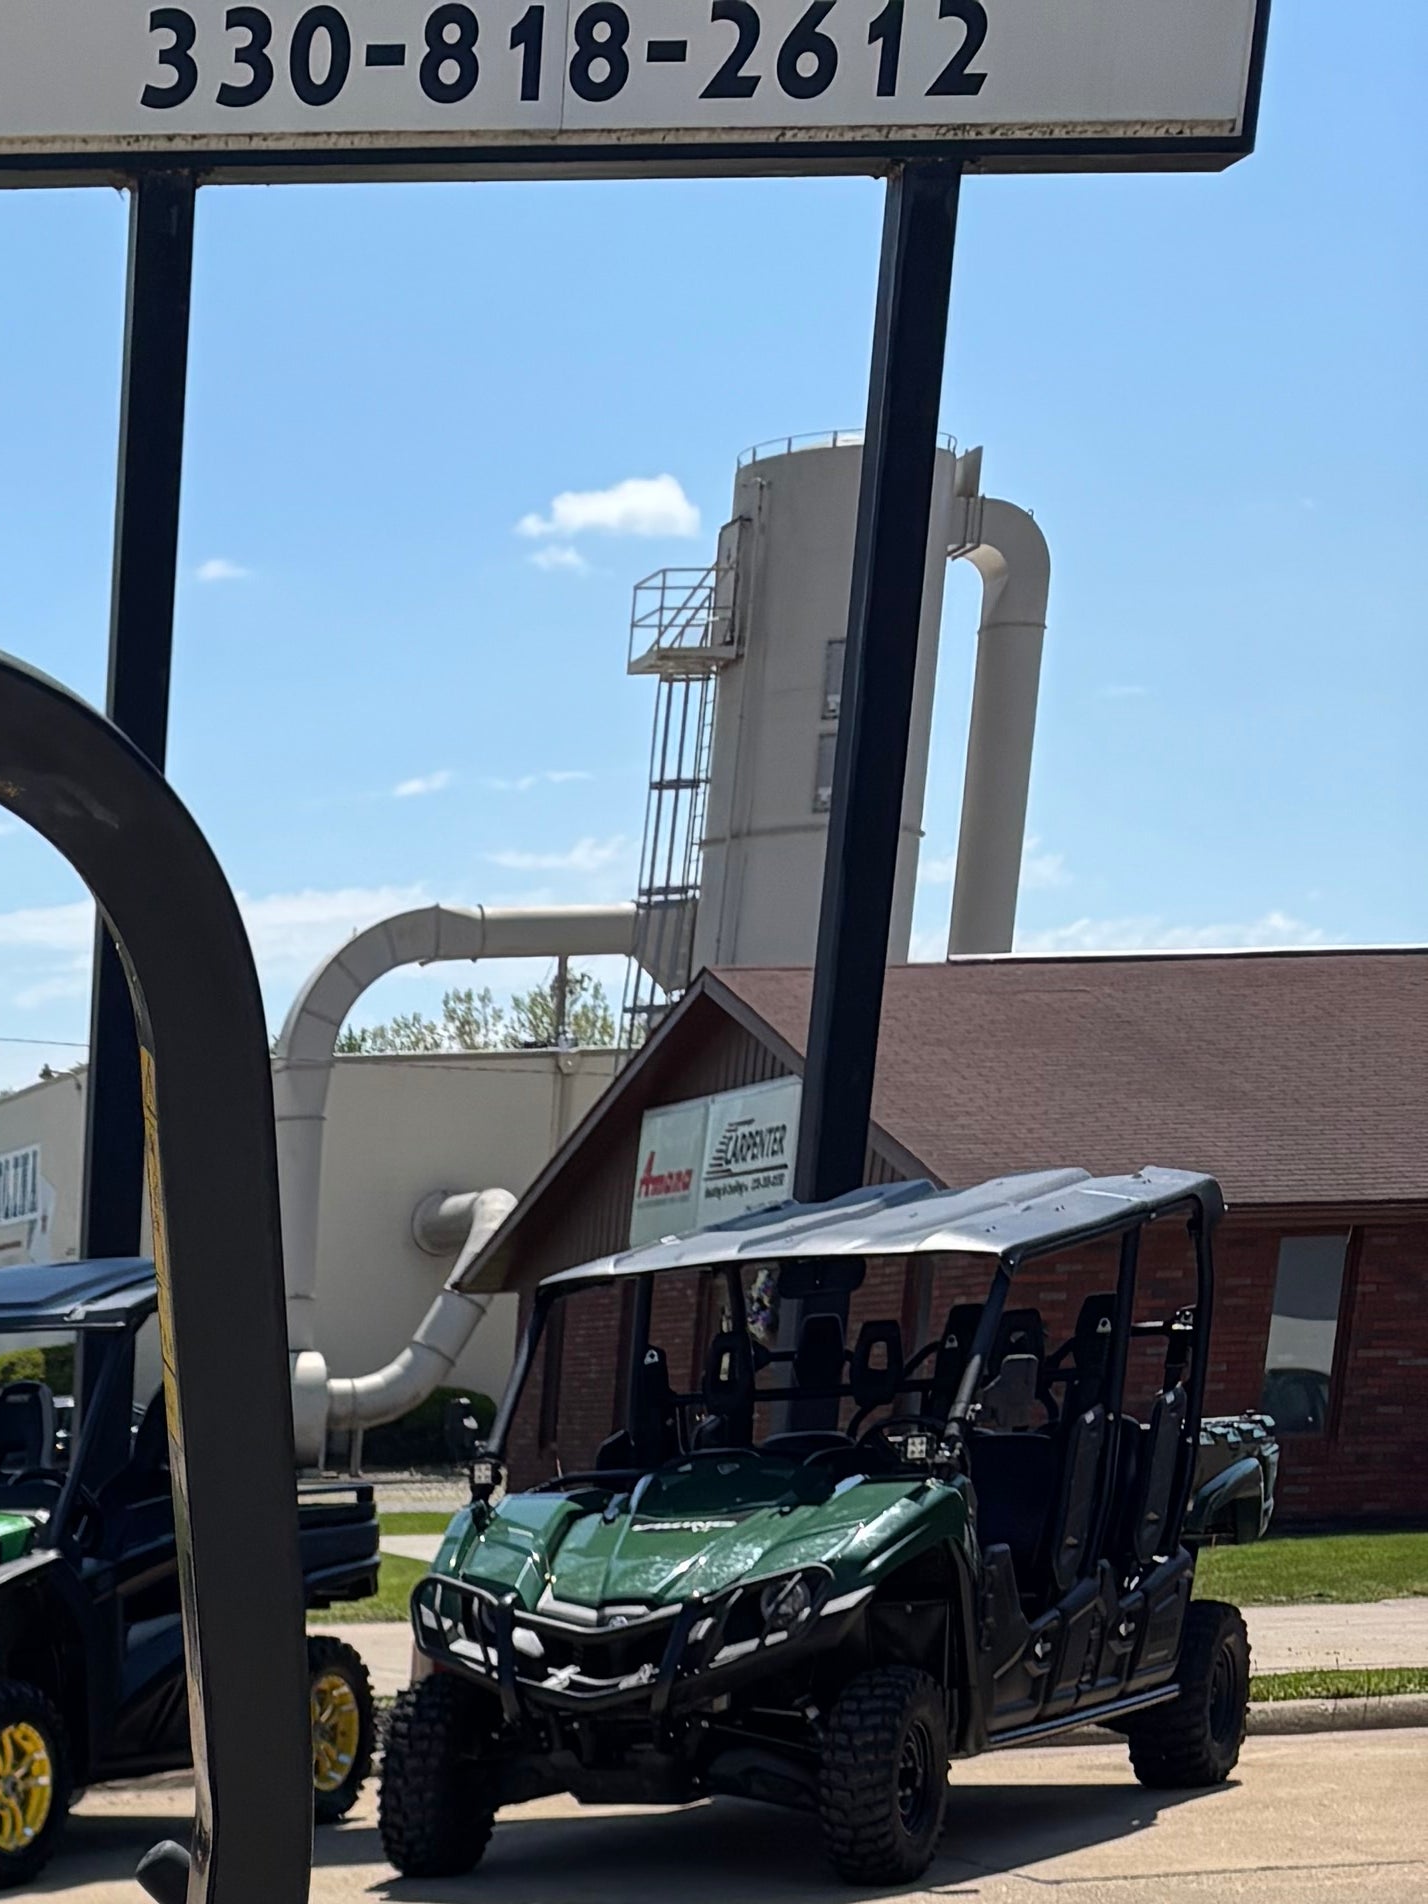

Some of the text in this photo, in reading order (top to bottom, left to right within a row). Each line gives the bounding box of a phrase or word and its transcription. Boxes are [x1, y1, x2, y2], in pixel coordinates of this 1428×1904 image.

[140, 0, 989, 109] 330-818-2612
[724, 1124, 787, 1164] CARPENTER
[638, 1151, 693, 1197] Amana
